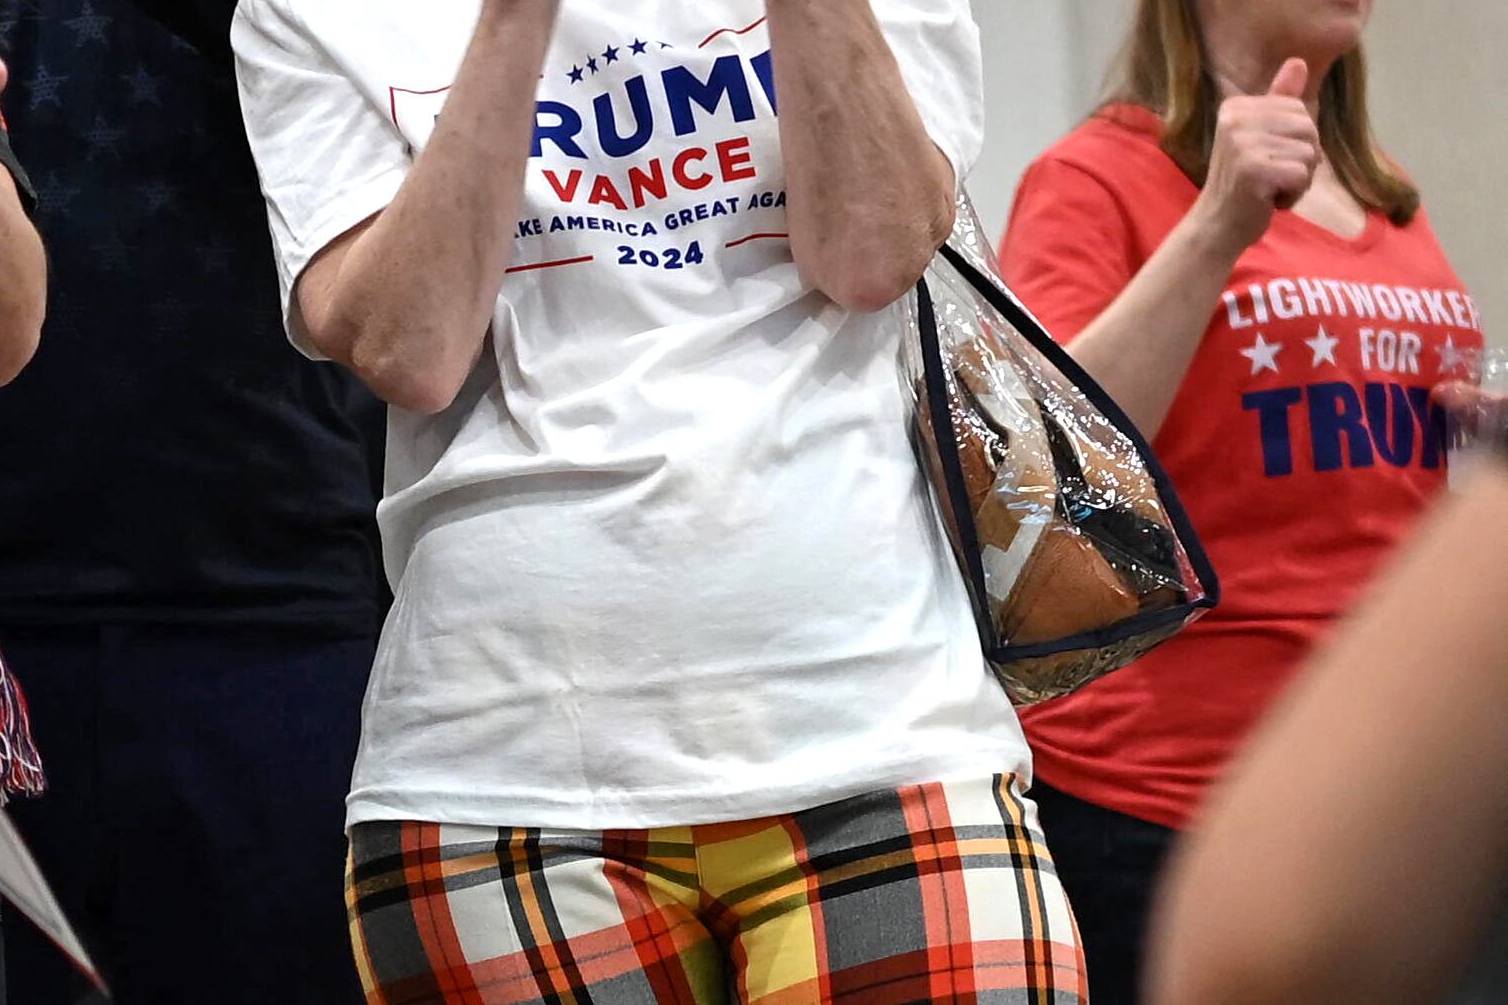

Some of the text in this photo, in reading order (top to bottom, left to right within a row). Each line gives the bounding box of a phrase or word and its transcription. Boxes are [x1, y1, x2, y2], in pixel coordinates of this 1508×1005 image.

[530, 49, 779, 161] RUM
[542, 136, 756, 211] VANCE
[514, 218, 544, 239] KE
[549, 215, 658, 237] AMERICA
[664, 197, 740, 231] GREAT
[617, 240, 704, 270] 2024
[1358, 328, 1422, 375] FOR
